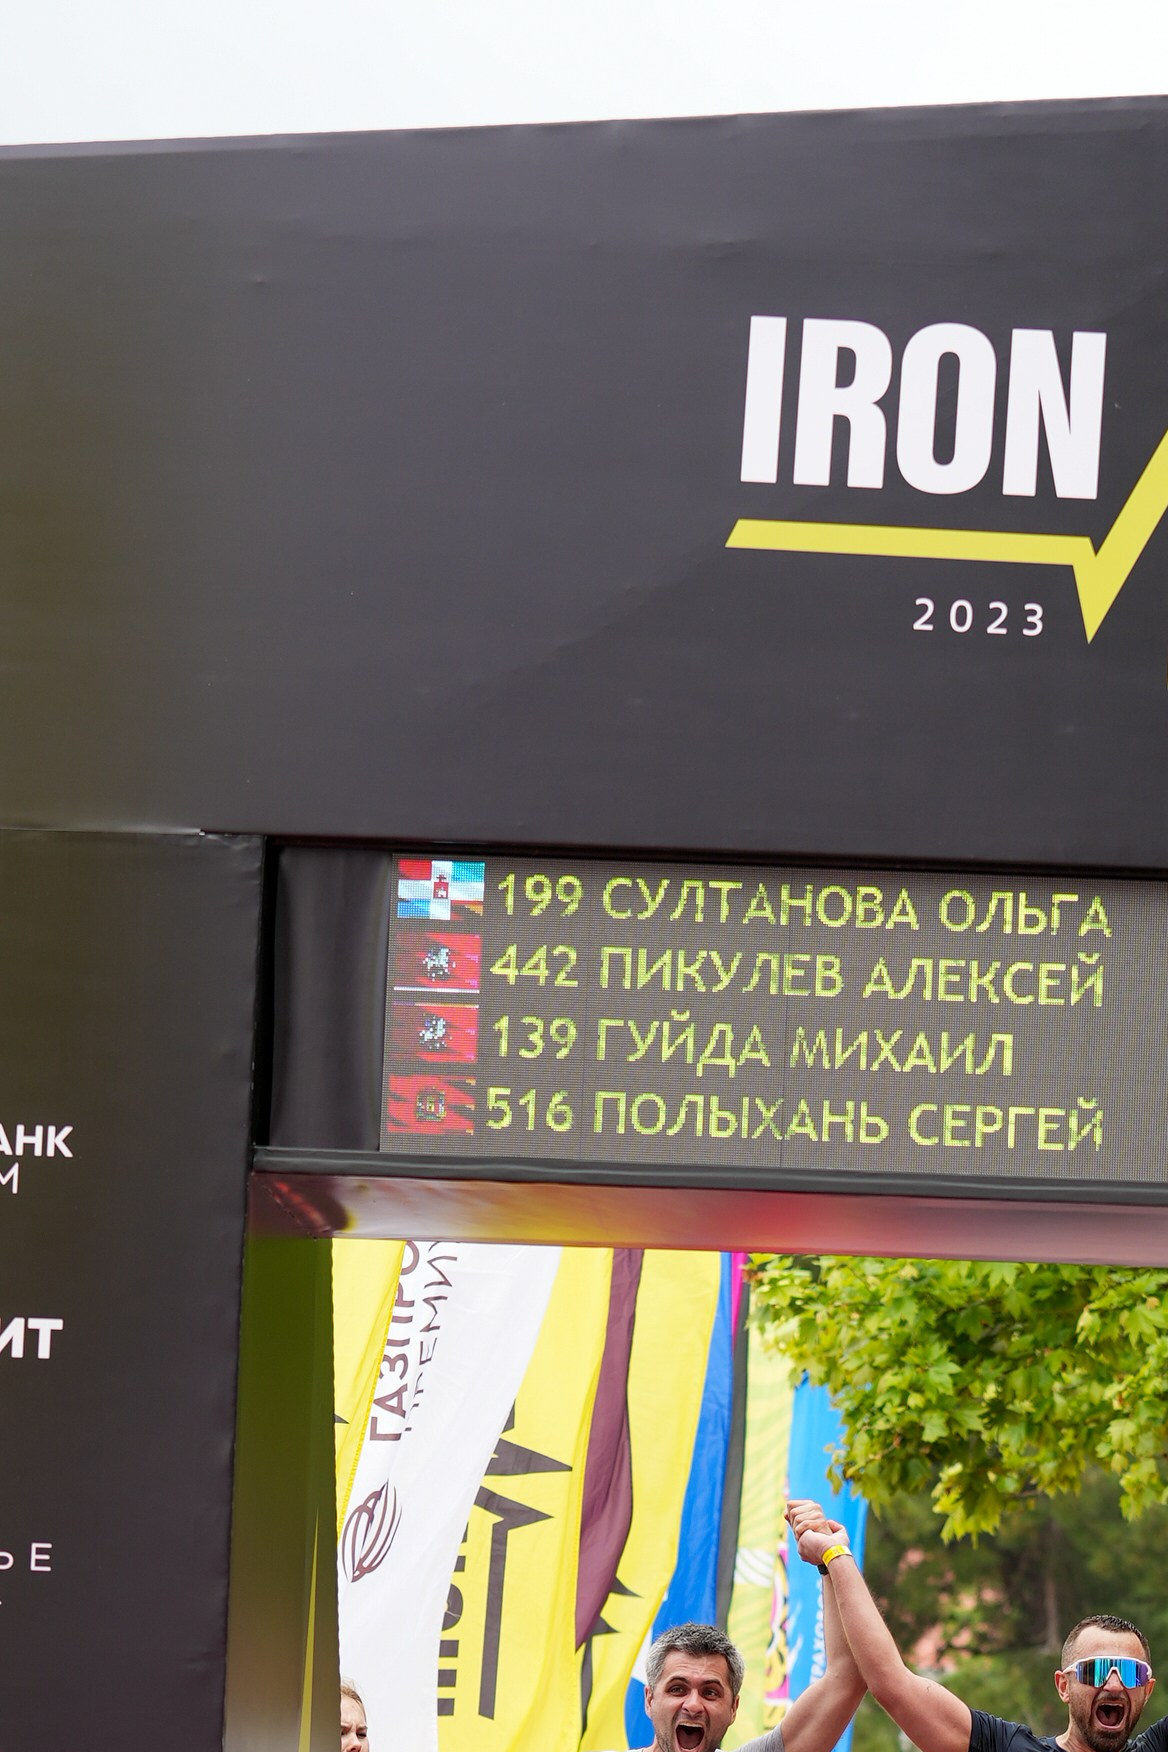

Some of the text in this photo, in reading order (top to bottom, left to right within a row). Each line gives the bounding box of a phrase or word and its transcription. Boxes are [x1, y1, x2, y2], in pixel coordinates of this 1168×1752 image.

[740, 315, 1107, 500] IRON
[913, 597, 1045, 636] 2023
[498, 873, 583, 917] 199
[602, 877, 920, 930] СУЛТАНОВА
[938, 889, 1112, 938] ОЛЬГА
[490, 943, 578, 988] 442
[600, 945, 845, 997] ПИКУЛЕВ
[862, 951, 1105, 1007] АЛЕКСЕЙ
[492, 1015, 578, 1060] 139
[596, 1009, 771, 1079] ГУЙДА
[789, 1026, 1014, 1076] МИХАИЛ
[486, 1086, 573, 1132] 516
[593, 1091, 890, 1144] ПОЛЫХАНЬ
[907, 1096, 1105, 1151] СЕРГЕЙ
